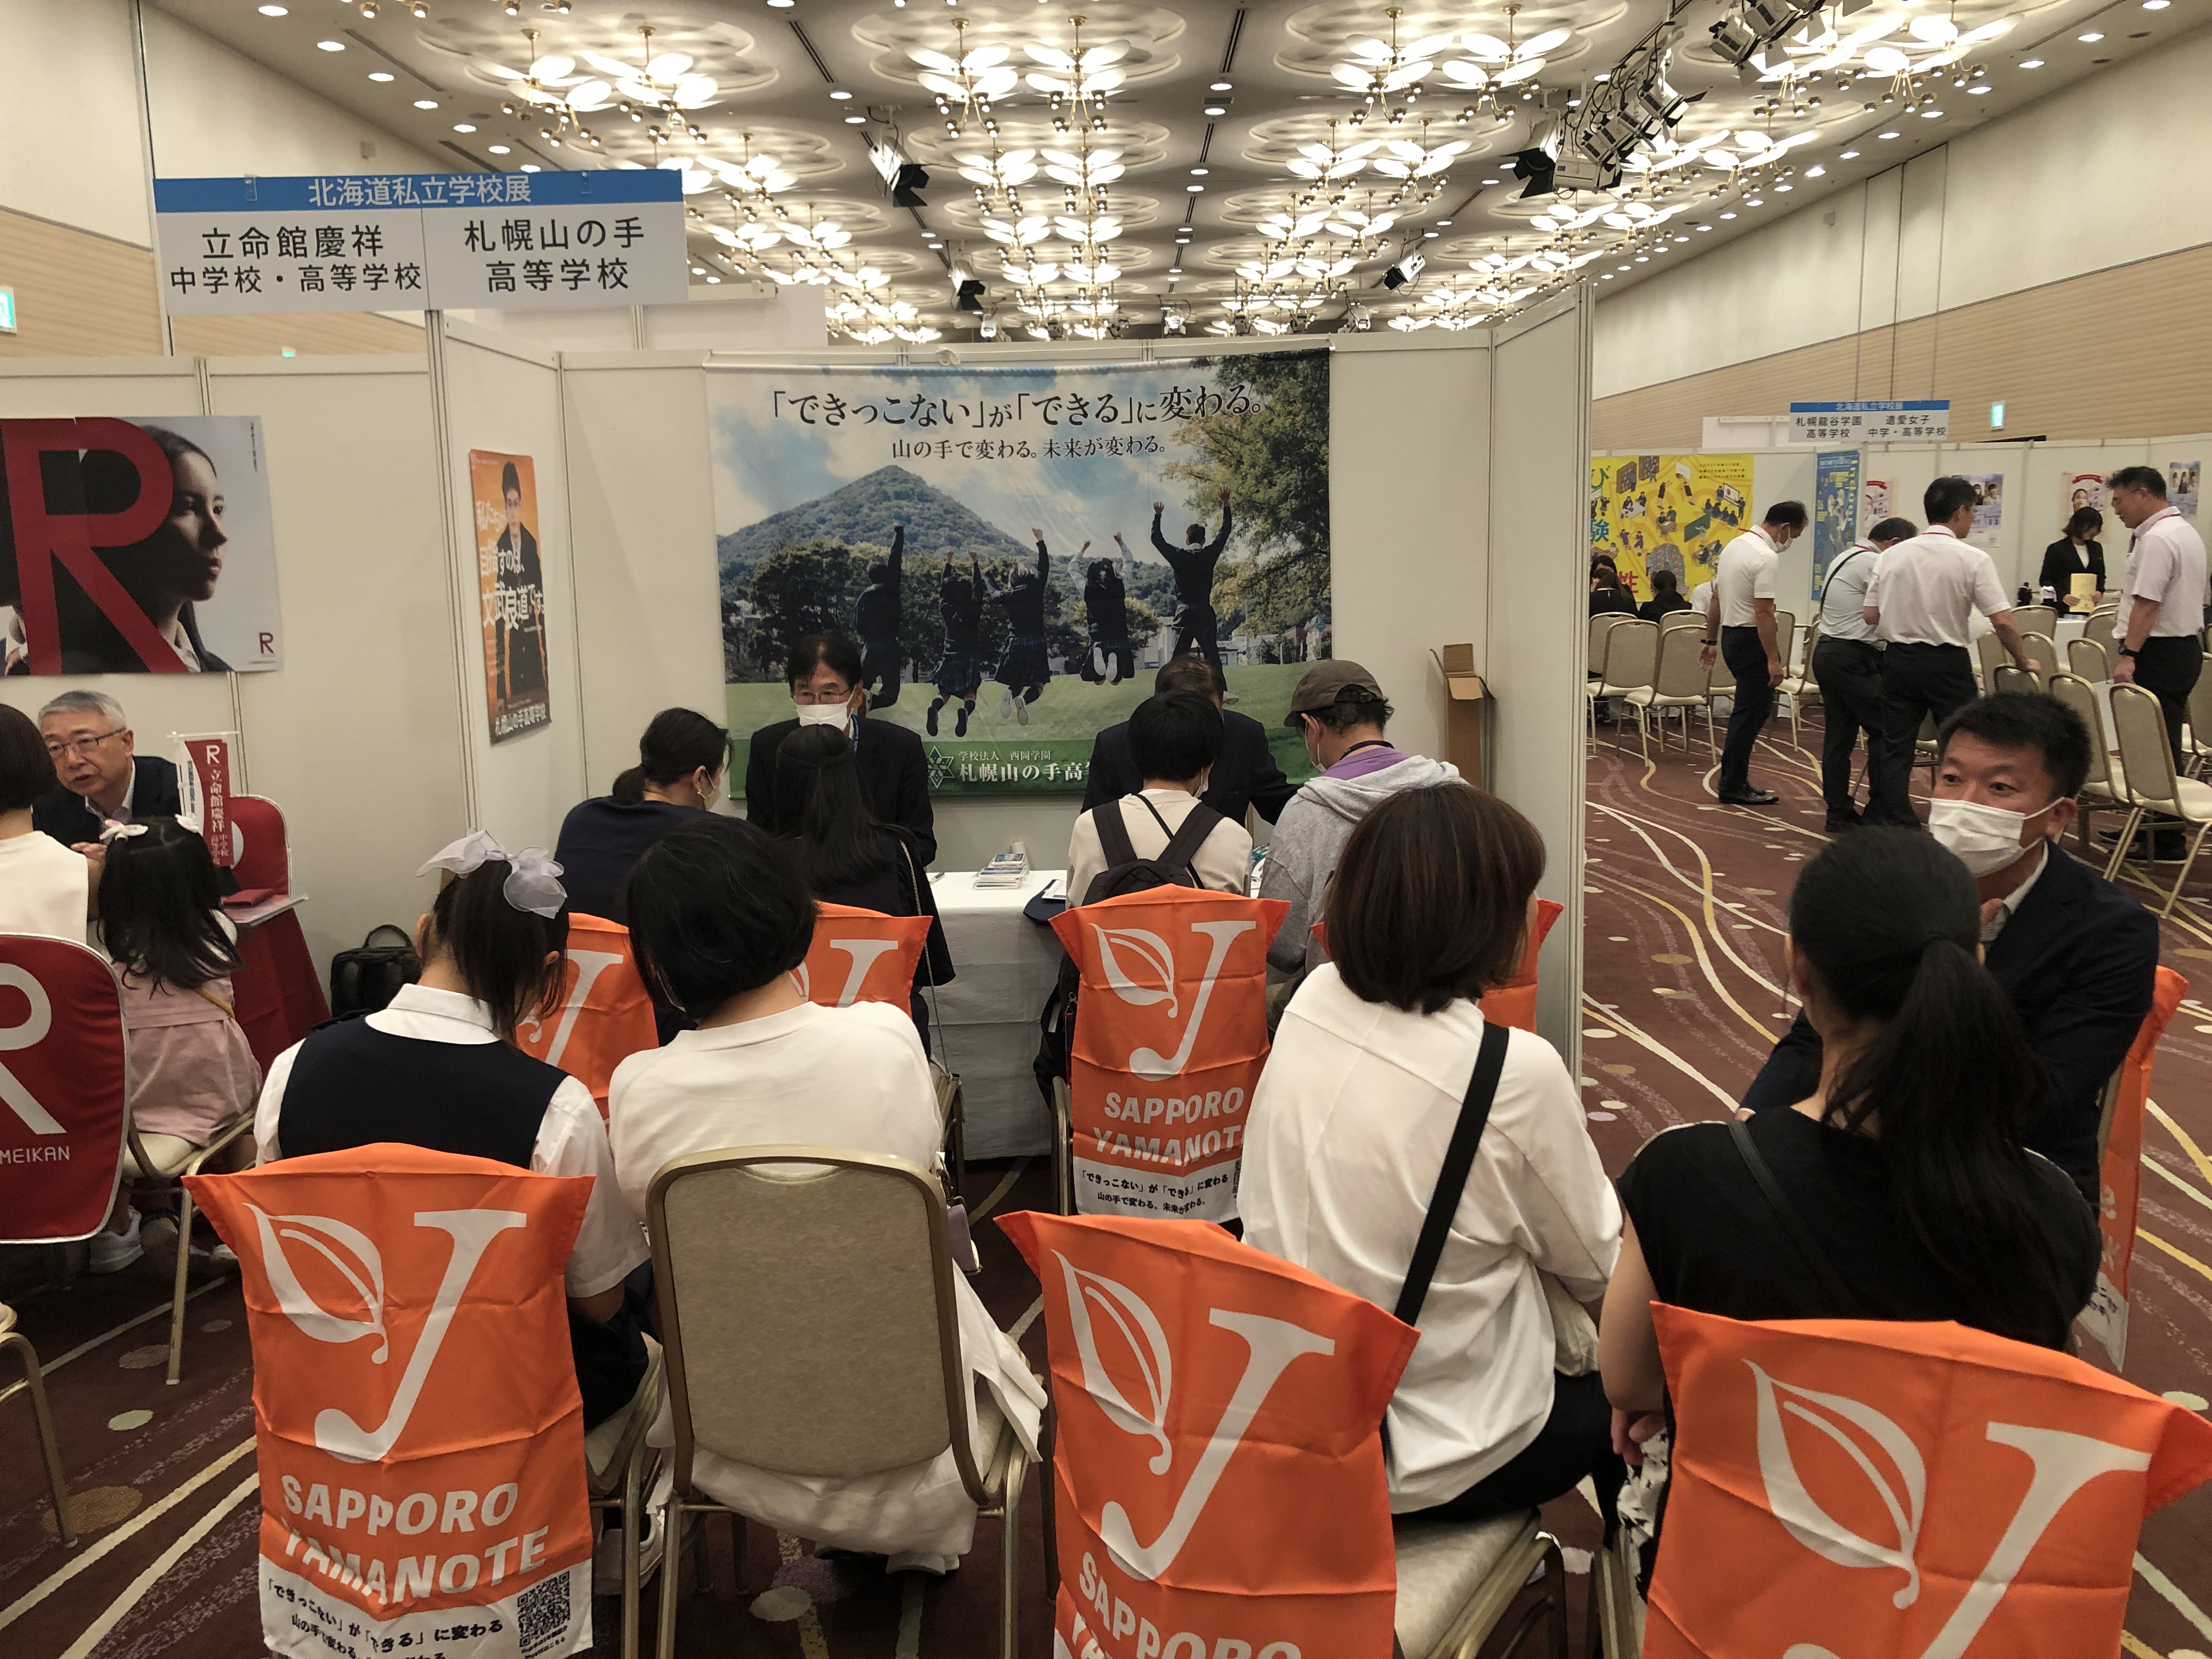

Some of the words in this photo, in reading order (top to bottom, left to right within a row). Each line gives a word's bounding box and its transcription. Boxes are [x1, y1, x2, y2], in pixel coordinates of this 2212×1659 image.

[308, 175, 531, 207] 北海道私立学校展
[202, 224, 383, 259] 立命館慶祥
[464, 217, 644, 252] 札幌山の手
[171, 262, 421, 294] 中学校・高等学校
[486, 258, 629, 293] 高等学校
[774, 386, 1261, 428] 「できっこない」が「できる」に変わる。
[1796, 416, 1863, 426] 札幌龍谷学園
[1836, 401, 1903, 410] 北海道私立学校展
[1886, 415, 1931, 425] 遺愛女子
[1807, 428, 1850, 438] 高等学校
[1869, 426, 1947, 437] 中学・高等学校
[893, 436, 1165, 460] 山の手で変わる。未来が変わる。
[0, 417, 189, 675] R
[258, 632, 275, 654] R
[206, 745, 220, 764] R
[959, 752, 1000, 761] 学校法人
[1011, 751, 1051, 760] 西岡学園
[960, 762, 1090, 782] 札幌山の手高
[1104, 1087, 1244, 1125] SAPPORO
[1093, 1124, 1246, 1166] YAMANOT
[281, 1475, 518, 1536] SAPPORO
[281, 1517, 549, 1605] YAMANOTE
